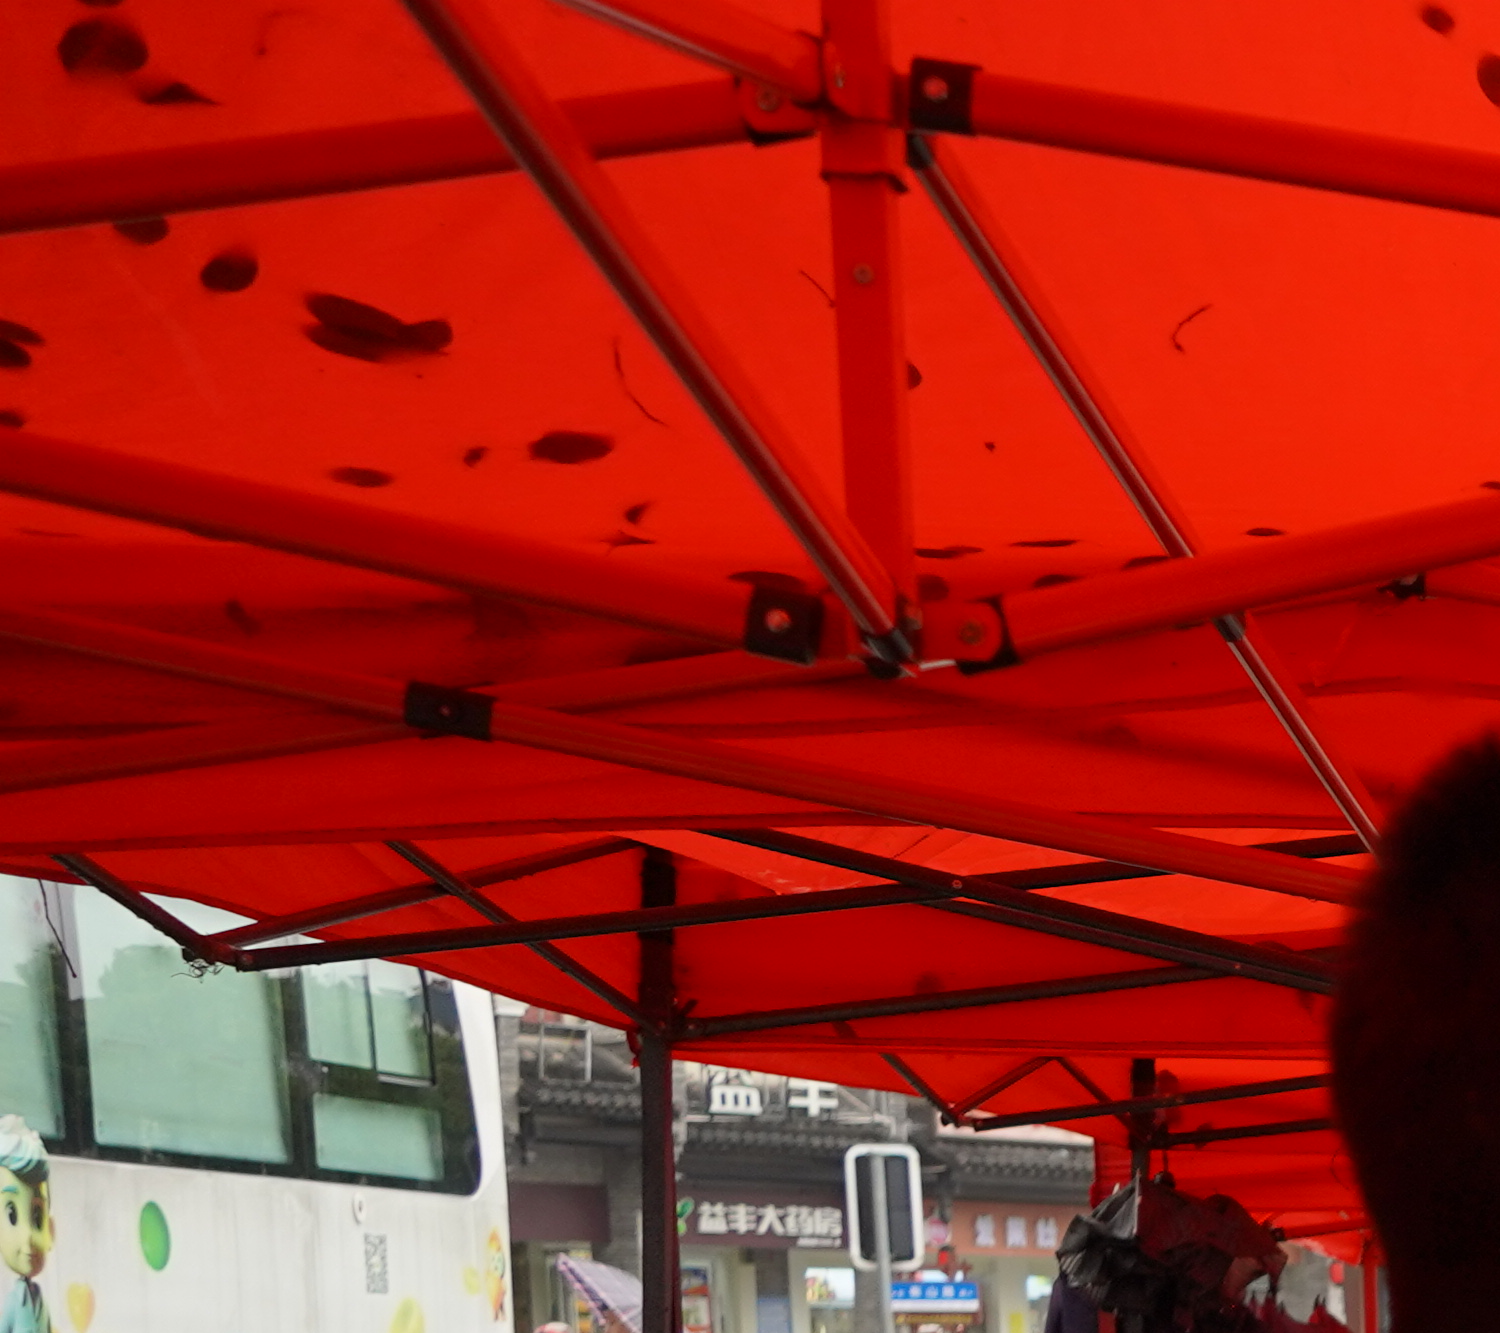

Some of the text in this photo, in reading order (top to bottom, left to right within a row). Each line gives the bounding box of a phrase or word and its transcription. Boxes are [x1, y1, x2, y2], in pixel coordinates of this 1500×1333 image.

[697, 1202, 844, 1238] 益丰大药房
